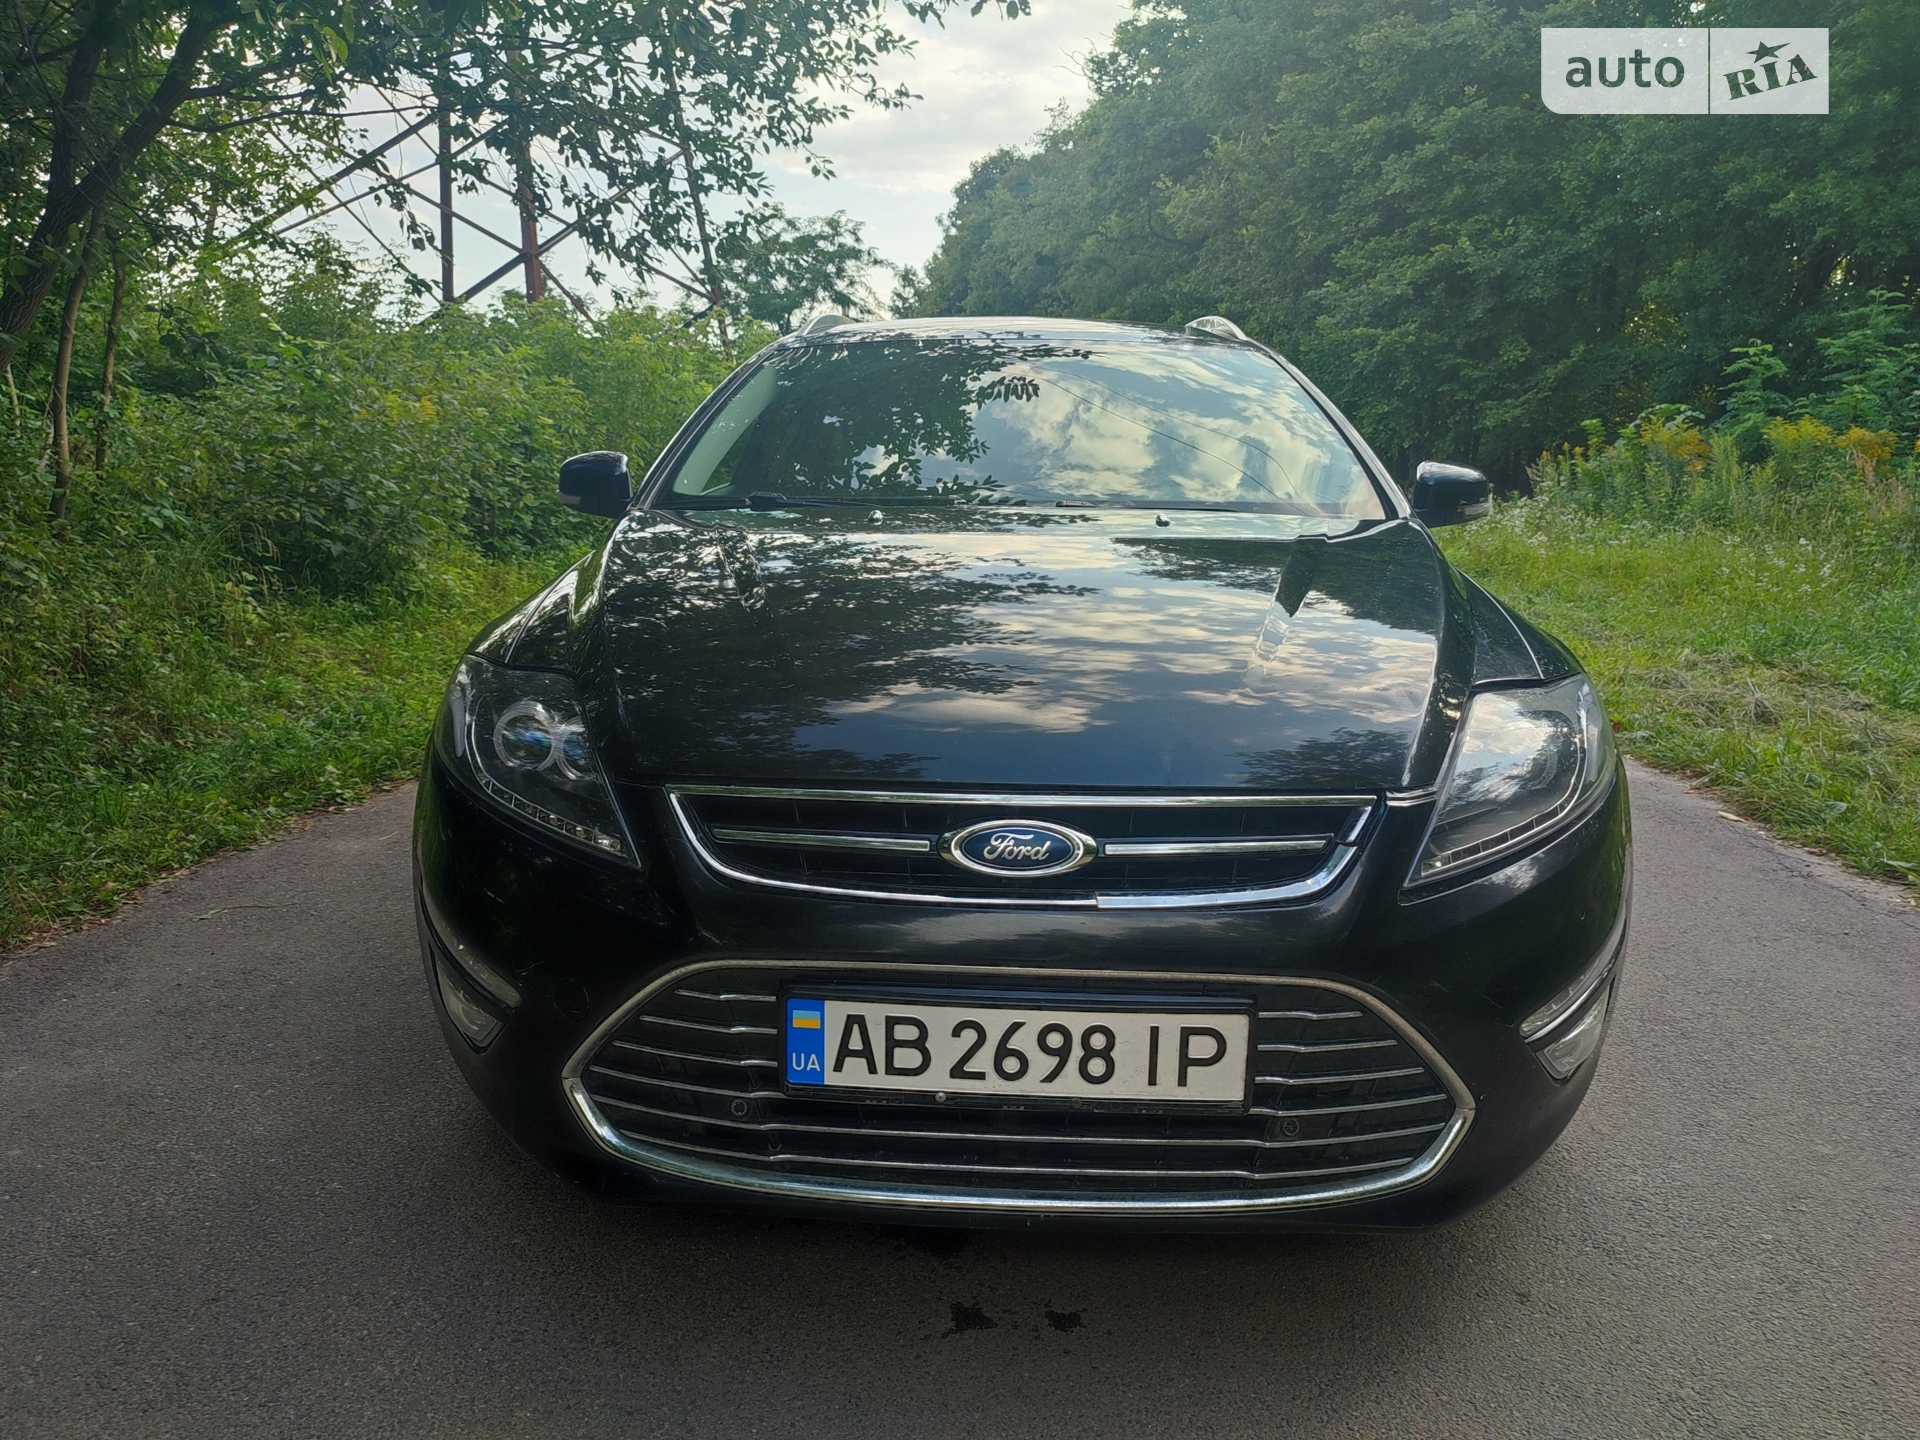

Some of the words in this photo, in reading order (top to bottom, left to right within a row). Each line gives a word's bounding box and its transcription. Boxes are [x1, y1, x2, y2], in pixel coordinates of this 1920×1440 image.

[983, 832, 1051, 861] Ford
[791, 1052, 821, 1072] UA
[832, 1013, 932, 1077] AB
[949, 1018, 1116, 1084] 2698
[1147, 1024, 1227, 1087] IP
